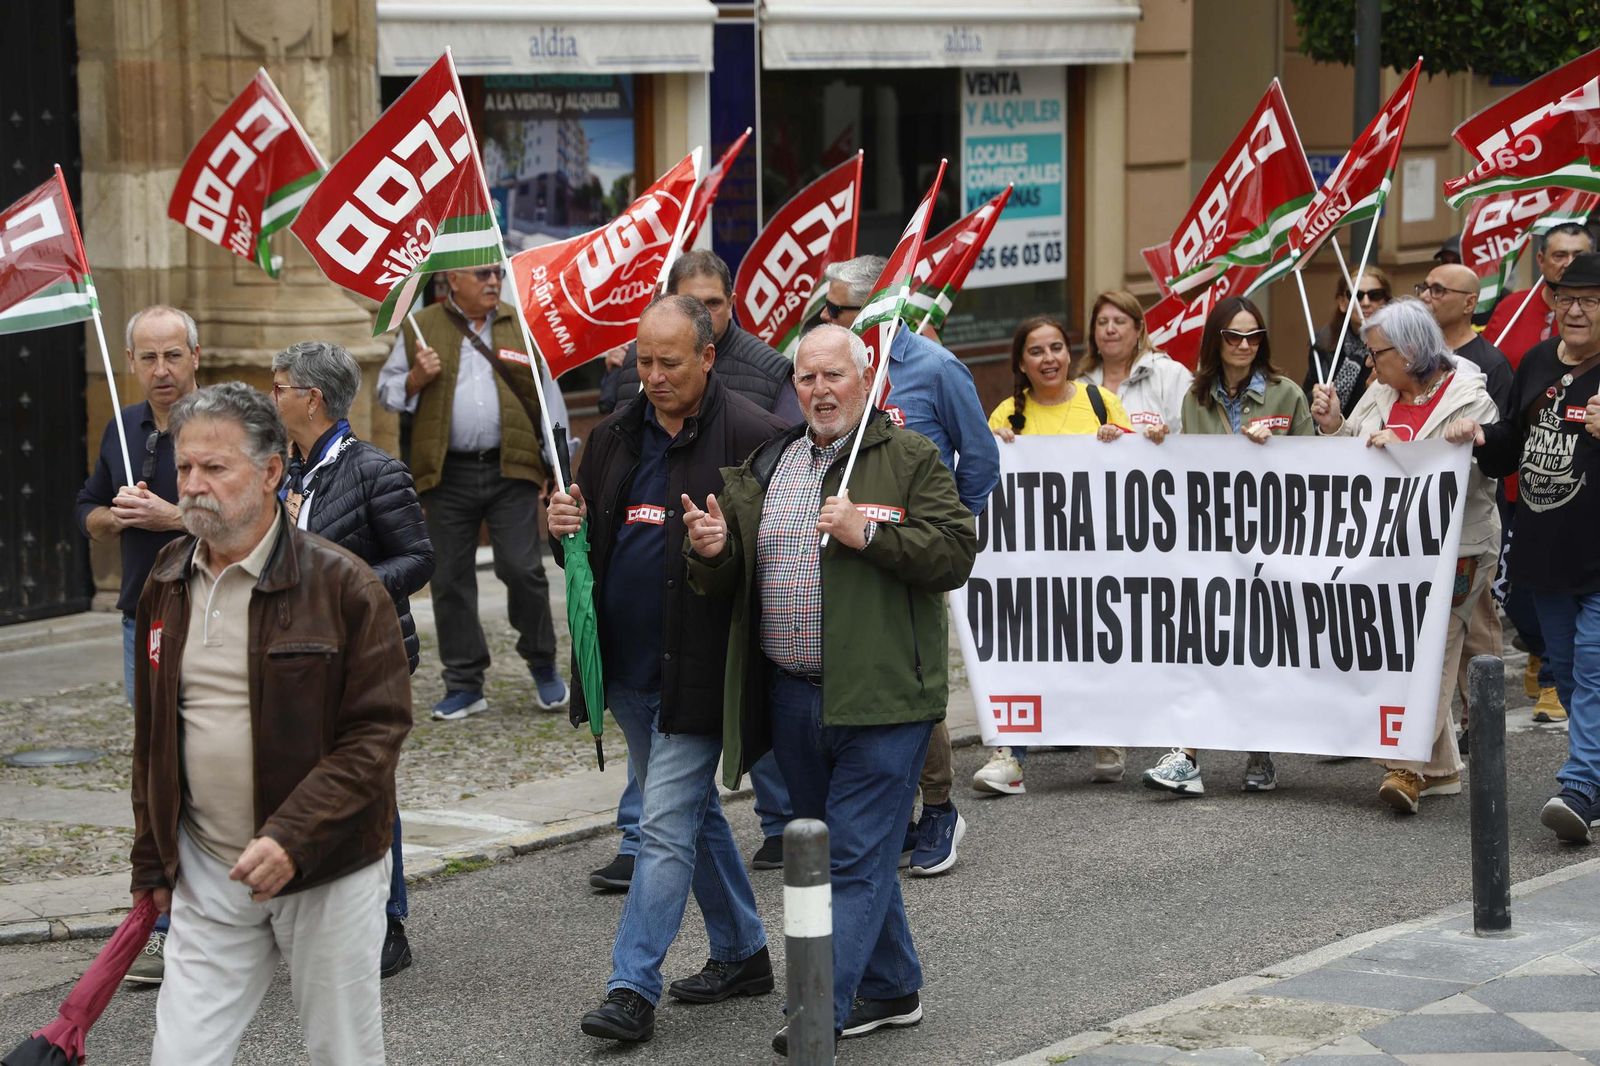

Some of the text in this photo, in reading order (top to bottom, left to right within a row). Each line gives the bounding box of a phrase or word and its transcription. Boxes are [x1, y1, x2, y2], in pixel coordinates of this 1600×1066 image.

[966, 70, 1021, 95] VENTA
[485, 93, 495, 110] A
[496, 93, 513, 110] LA
[513, 93, 554, 111] VENTA
[564, 92, 620, 112] ALQUILER
[981, 100, 1060, 128] ALQUILER
[968, 143, 1028, 165] LOCALES
[968, 164, 1060, 188] COMERCIALES
[576, 196, 674, 292] UGT
[972, 240, 1062, 270] 56 66 03 03
[532, 264, 576, 357] www.ugtes
[1567, 408, 1586, 420] CC
[976, 471, 1096, 553] NTRA
[1105, 469, 1176, 552] LOS
[1187, 470, 1373, 559] RECORTES
[1369, 476, 1420, 557] EN
[967, 562, 1433, 672] DMINISTRACIÓN PÚBLI
